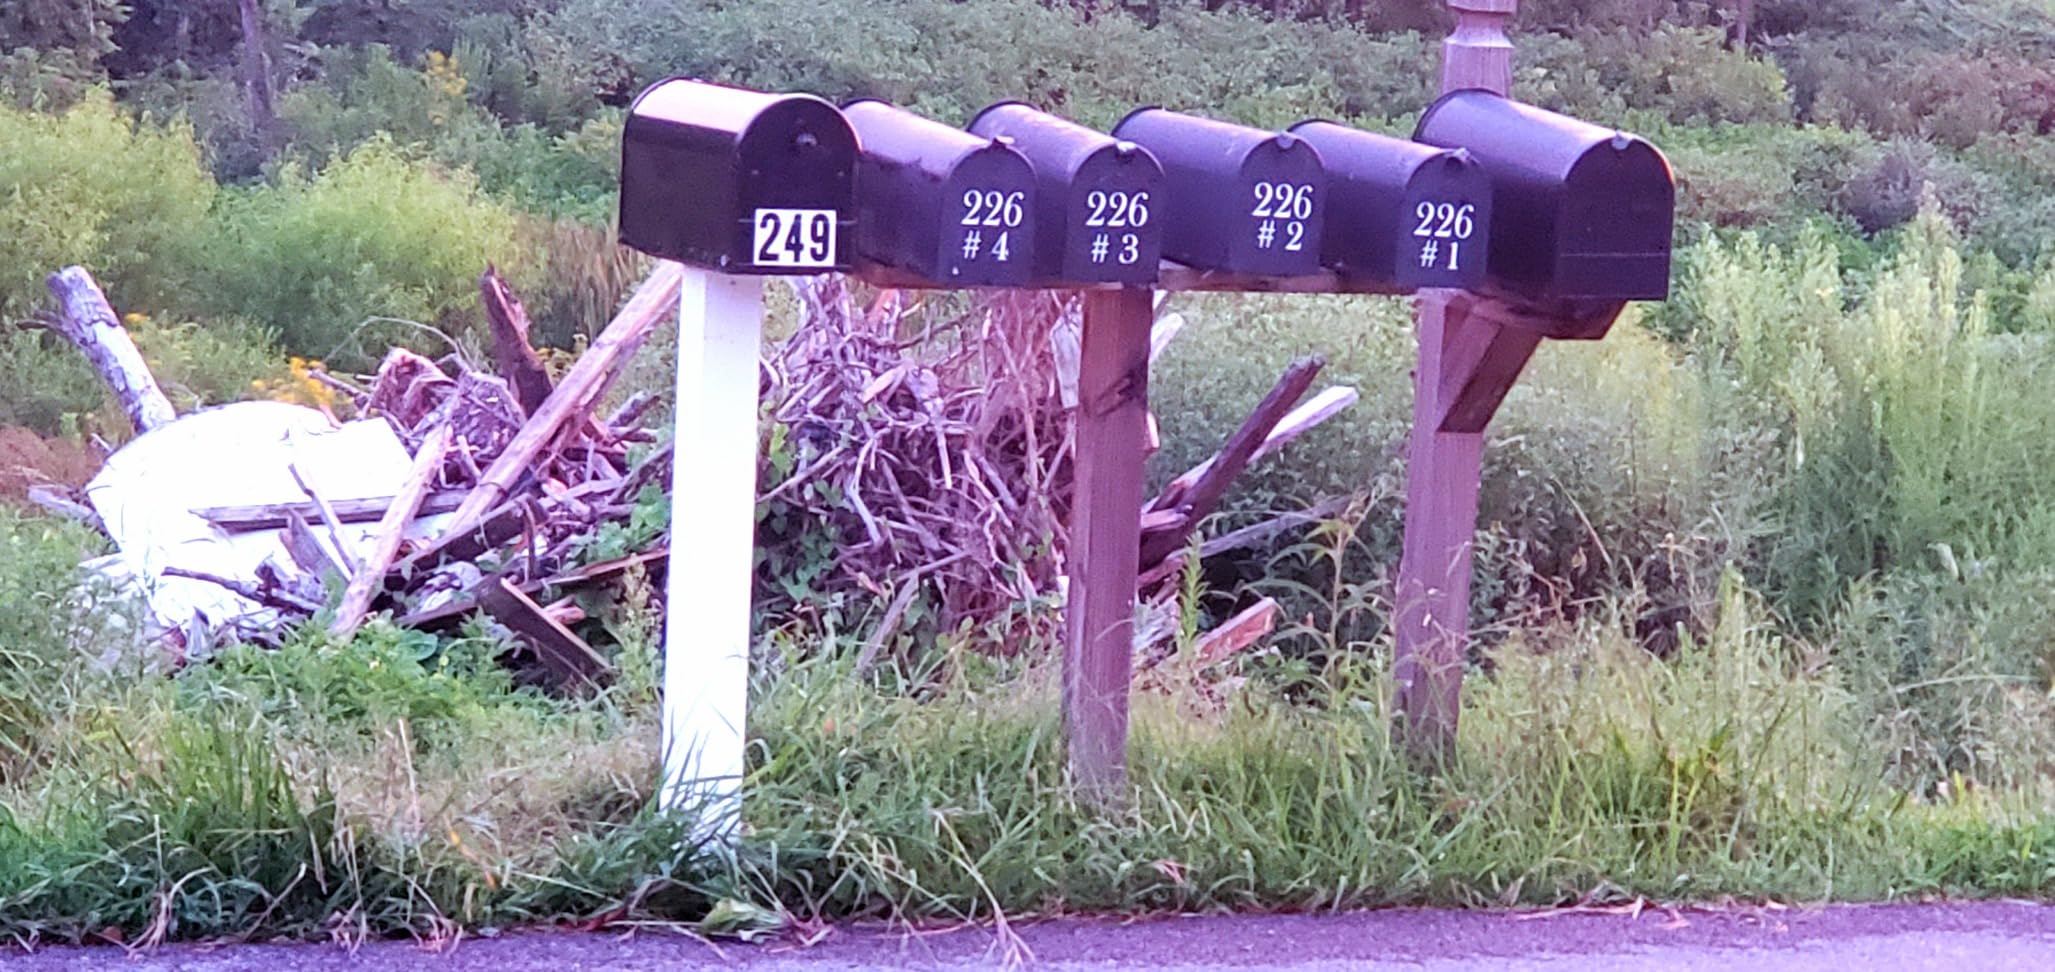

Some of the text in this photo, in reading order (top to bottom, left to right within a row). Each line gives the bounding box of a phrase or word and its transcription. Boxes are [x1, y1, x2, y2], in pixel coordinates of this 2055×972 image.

[960, 189, 1025, 227] 226
[1085, 191, 1149, 227] 226
[1251, 182, 1313, 220] 226
[758, 212, 831, 263] 249
[1413, 202, 1475, 239] 226
